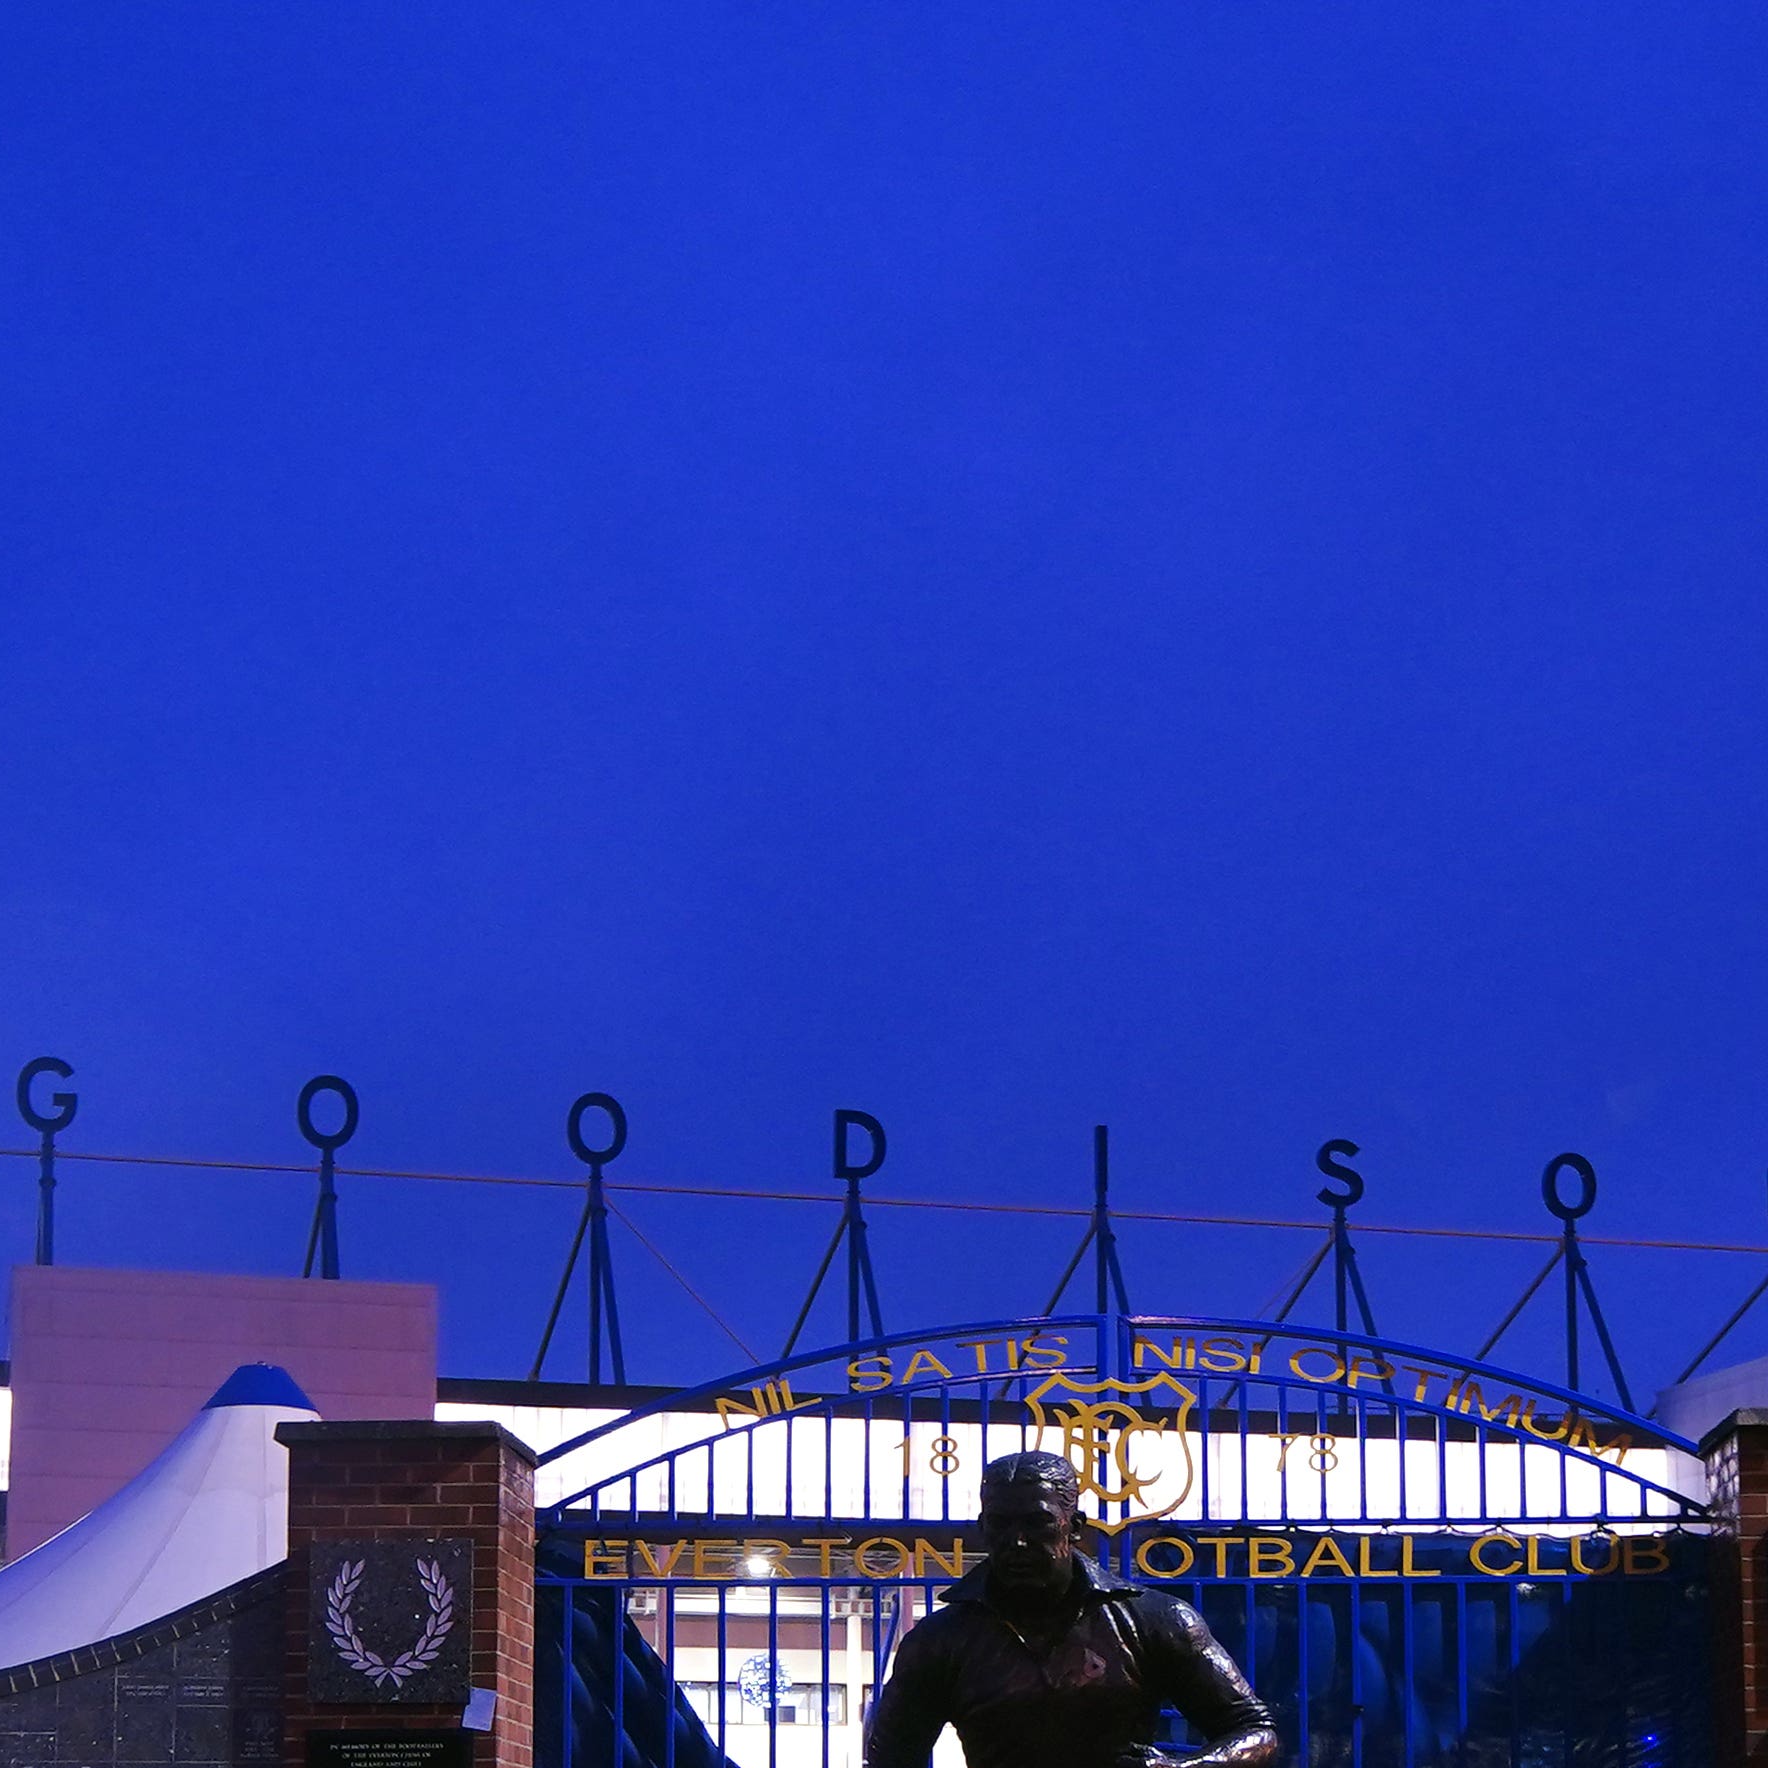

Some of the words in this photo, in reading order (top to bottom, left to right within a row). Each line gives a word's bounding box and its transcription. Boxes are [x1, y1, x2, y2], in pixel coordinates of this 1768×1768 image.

[714, 1379, 822, 1432] NIL
[846, 1334, 1070, 1393] SATIS
[1133, 1333, 1262, 1374] NISI
[1287, 1346, 1635, 1469] OPTIMUM
[582, 1535, 964, 1581] EVERTON
[1468, 1531, 1671, 1578] CLUB
